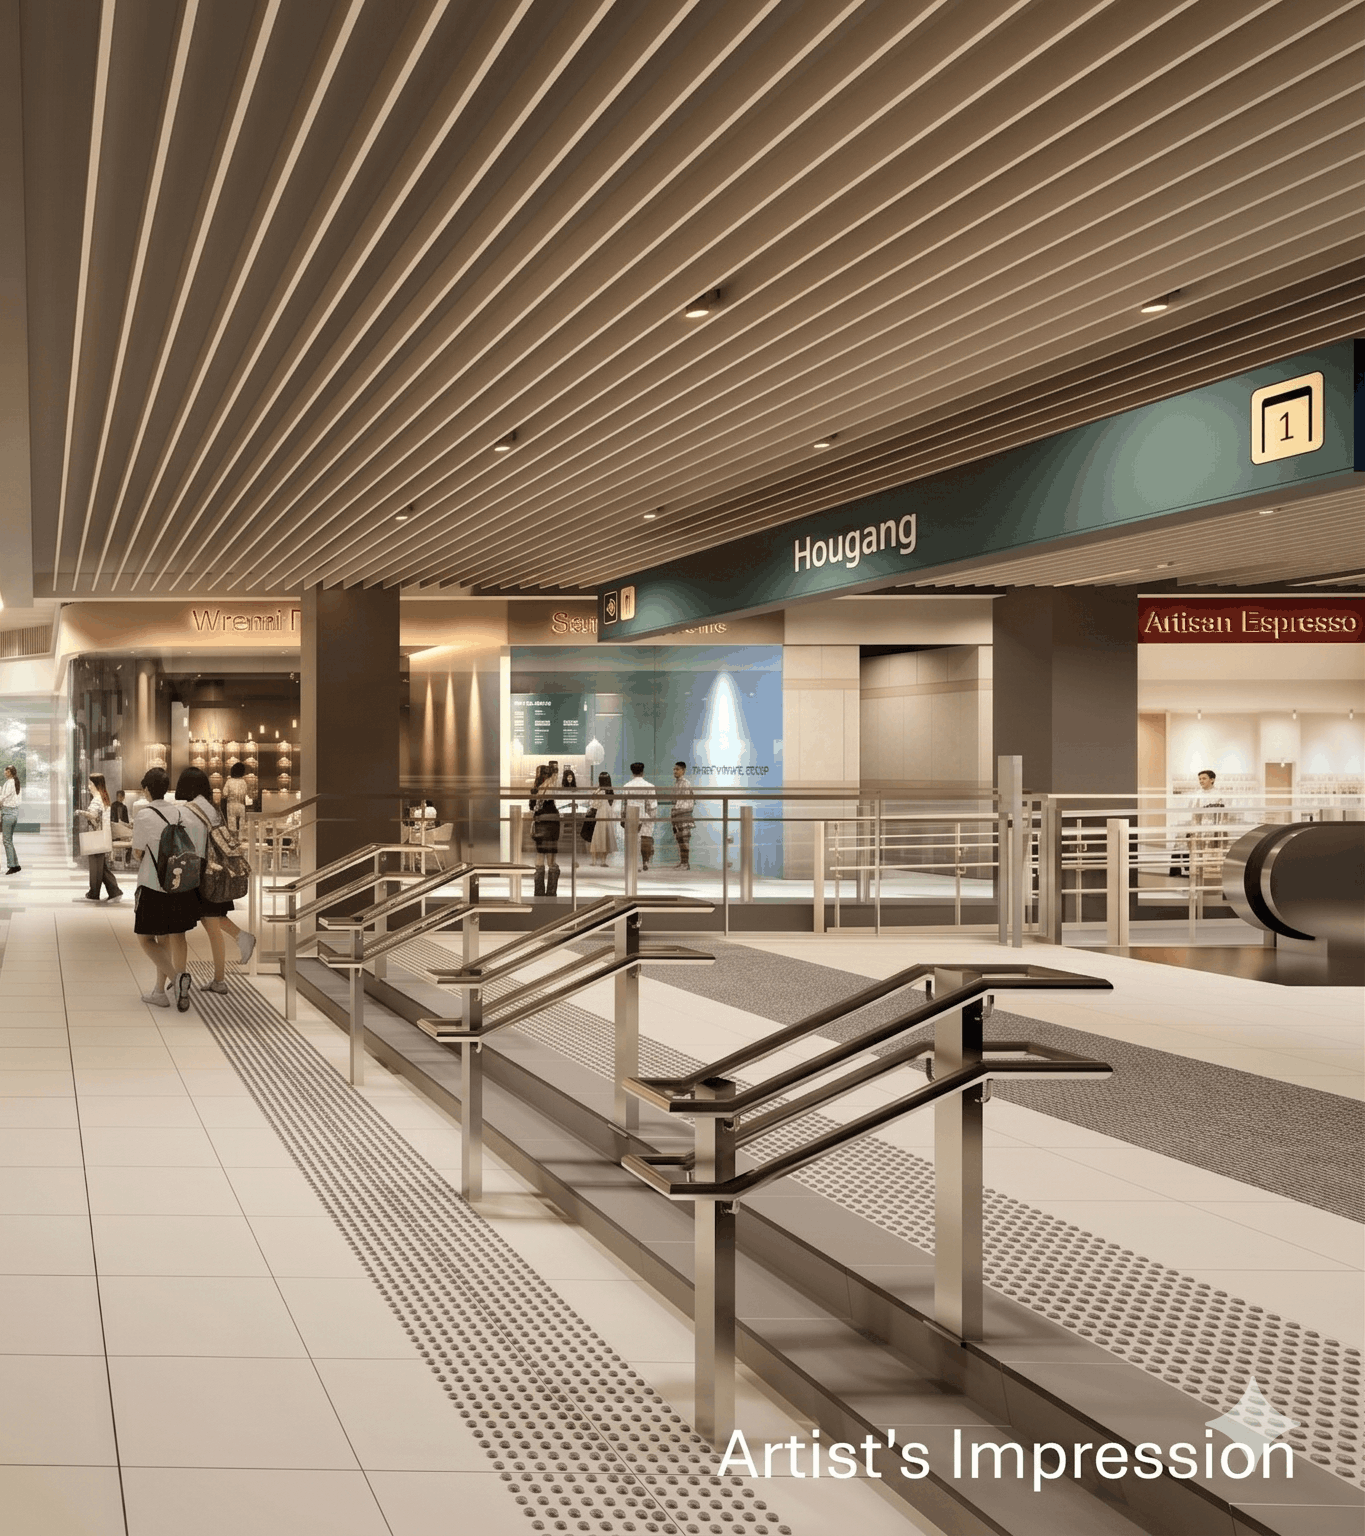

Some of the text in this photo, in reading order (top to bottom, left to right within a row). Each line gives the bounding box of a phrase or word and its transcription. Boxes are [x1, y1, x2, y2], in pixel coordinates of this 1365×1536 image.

[1279, 411, 1294, 442] 1
[794, 513, 917, 573] Hougang
[1241, 610, 1357, 639] Espresso
